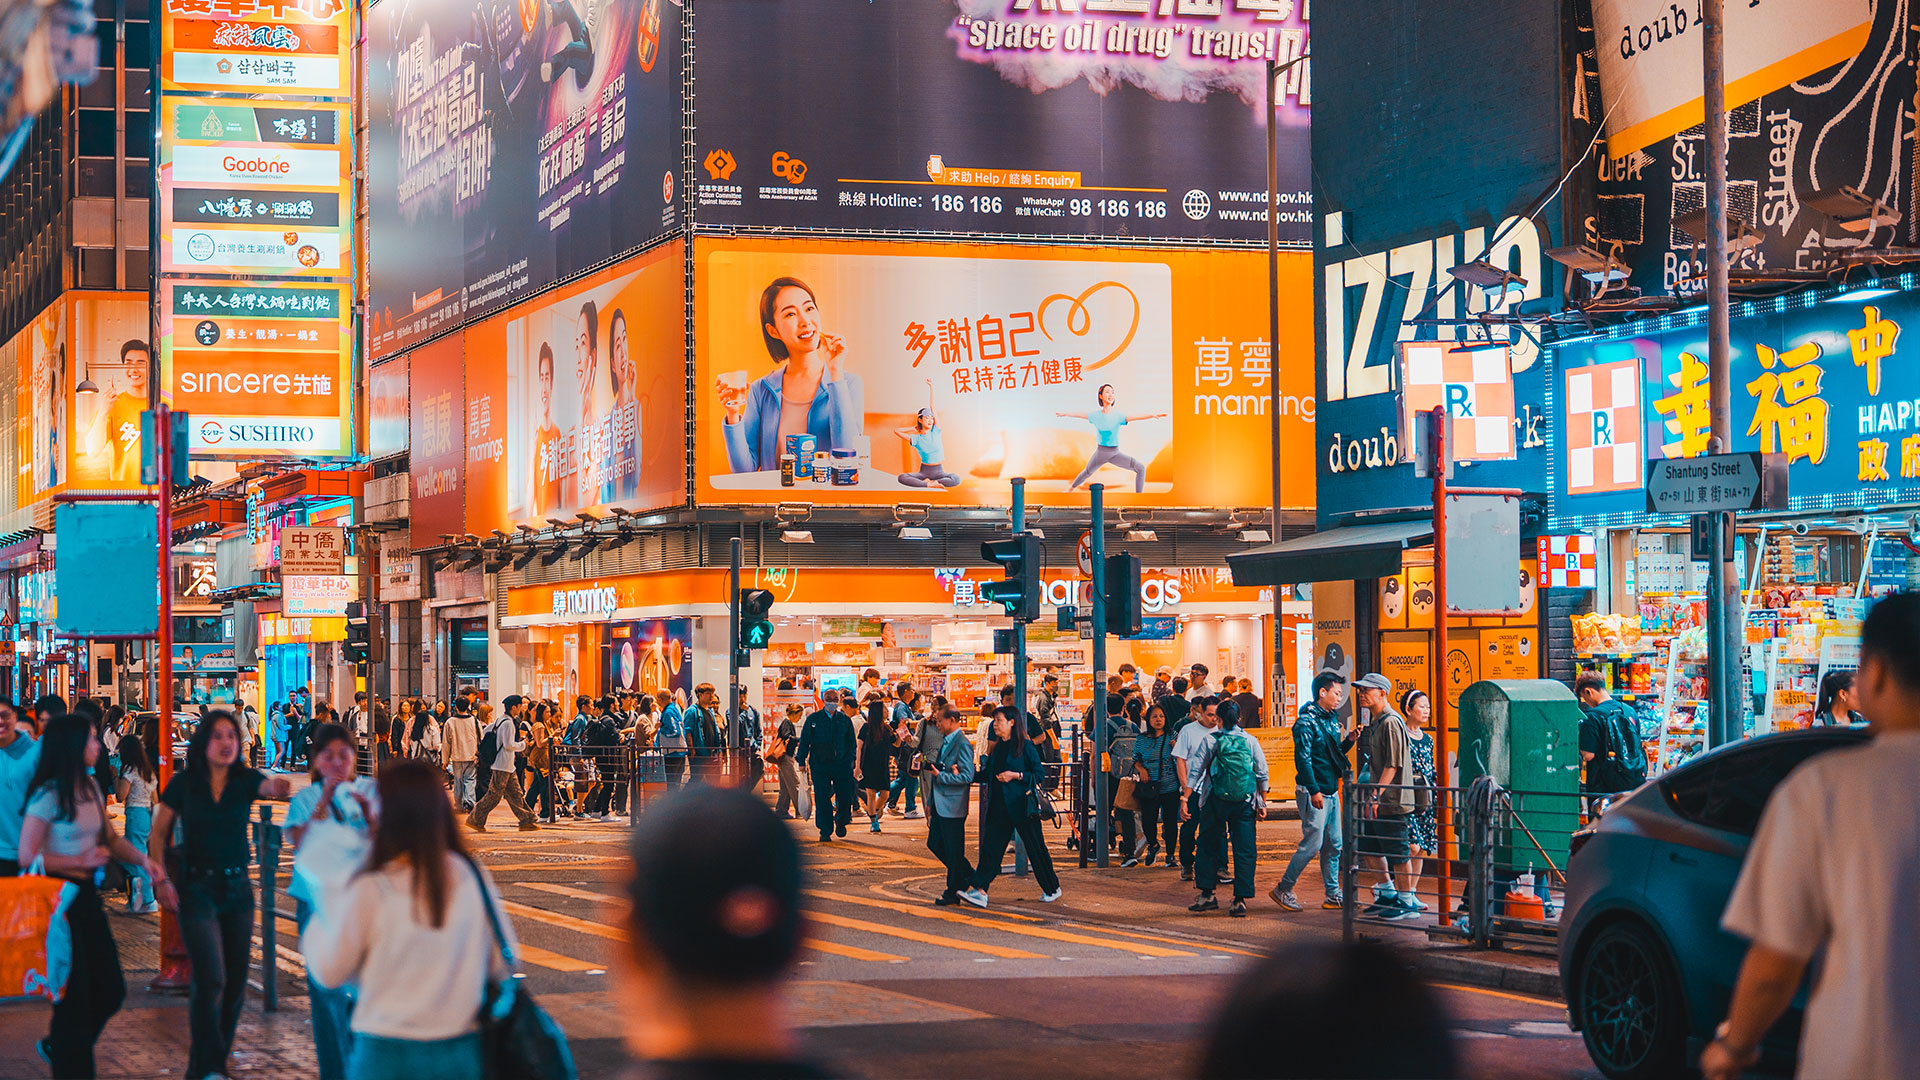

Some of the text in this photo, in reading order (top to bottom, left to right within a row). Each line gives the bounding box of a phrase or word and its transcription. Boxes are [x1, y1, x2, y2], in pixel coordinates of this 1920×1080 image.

[1064, 20, 1101, 50] oil
[1192, 26, 1276, 60] traps!
[223, 156, 290, 174] Goobne
[1762, 109, 1792, 226] Street
[949, 171, 971, 183] 求助
[975, 171, 999, 185] Help
[1034, 174, 1075, 187] Enquiry
[838, 192, 1003, 213] 熱線 Hotline: 186 186
[1070, 199, 1167, 218] 98 186 186
[1218, 190, 1313, 206] www.ndgov.hk
[1015, 207, 1031, 216] 微信
[1218, 209, 1313, 224] www.ndgov.hk
[903, 313, 1041, 369] 多謝自己
[1193, 335, 1281, 388] 萬寧
[180, 372, 291, 394] sincere
[293, 374, 332, 396] 先施
[952, 356, 1084, 395] 保持活力健康
[1858, 399, 1920, 435] HAP
[229, 425, 314, 442] SUSHIRO
[469, 437, 503, 463] mannings
[614, 456, 636, 479] BETTER
[1666, 461, 1741, 479] Shantung Street
[416, 466, 457, 499] wellcome
[1684, 485, 1721, 504] 山東街
[291, 531, 335, 549] 中僑
[567, 582, 616, 619] mannings
[1395, 679, 1417, 691] Tanuki
